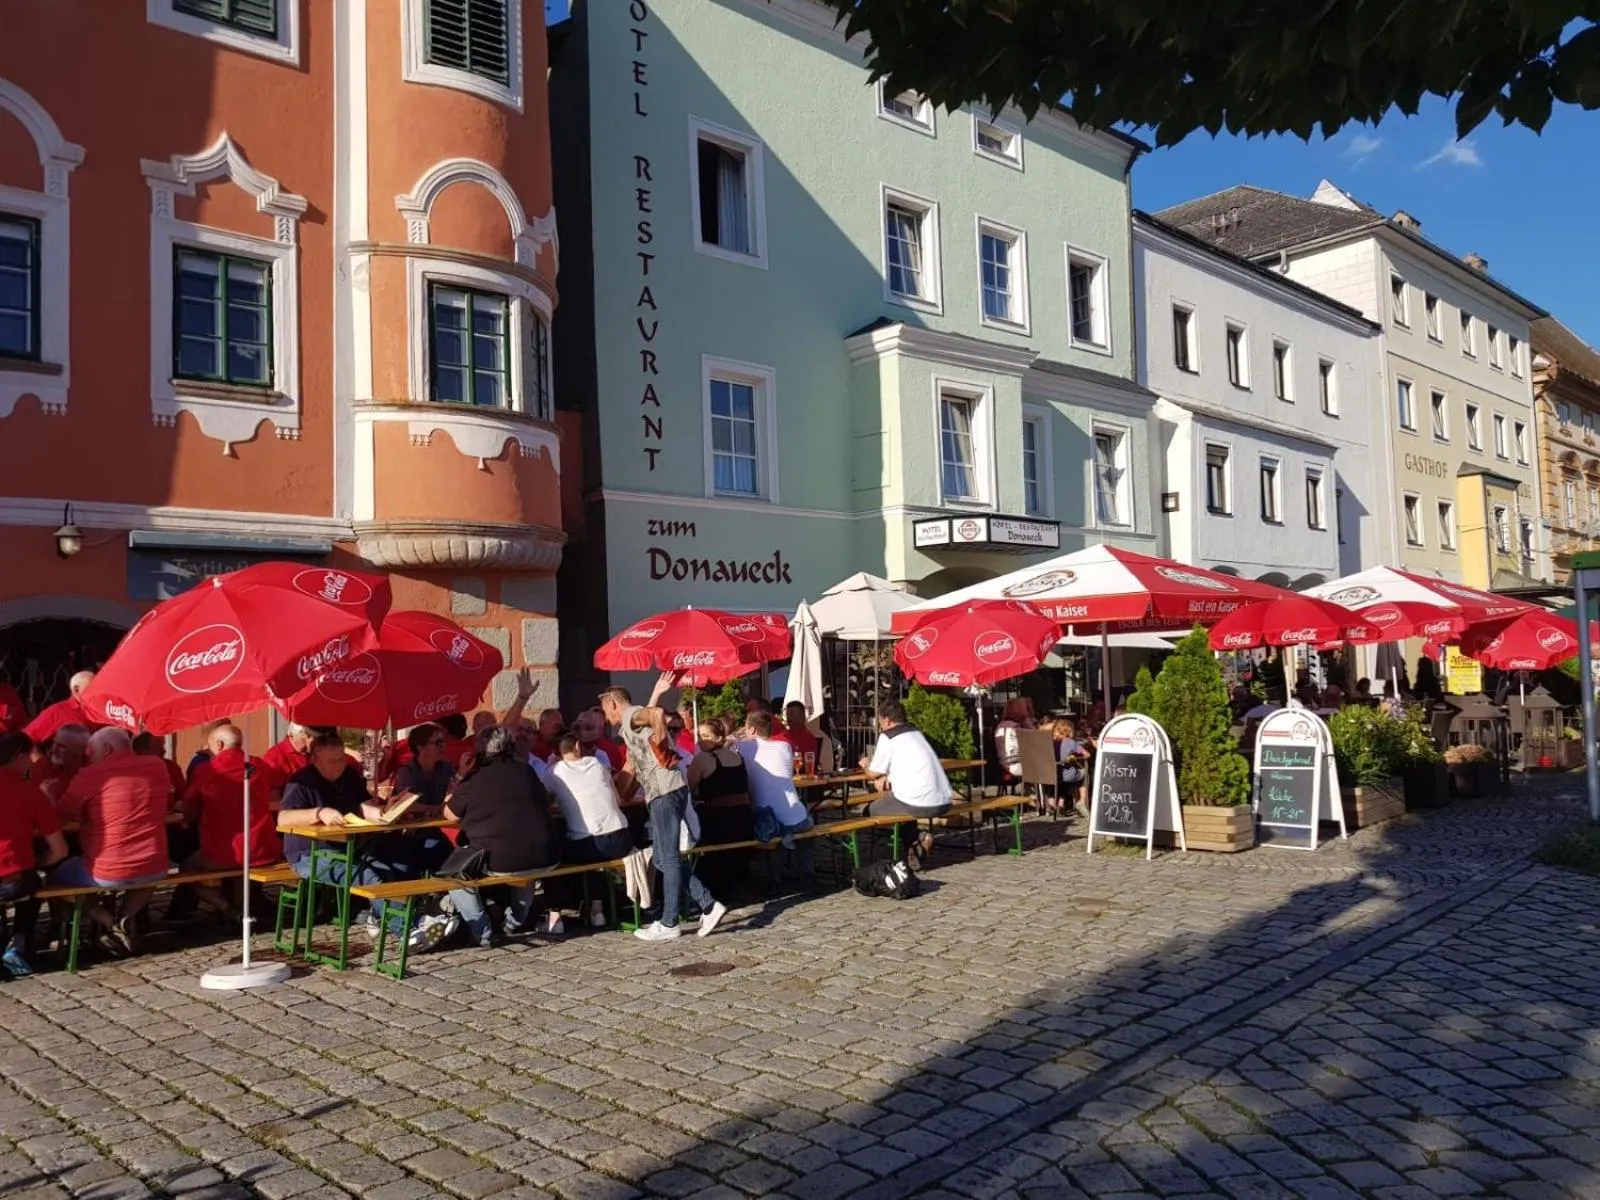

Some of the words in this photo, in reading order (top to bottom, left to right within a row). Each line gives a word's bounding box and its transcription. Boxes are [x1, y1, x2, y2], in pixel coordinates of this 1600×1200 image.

[1404, 452, 1449, 478] GASTHOF
[647, 519, 697, 537] zum
[646, 547, 793, 584] Donaueck
[1056, 604, 1088, 617] Kaiser
[1224, 632, 1252, 646] Coca-Cola
[1281, 628, 1318, 642] Coca-Cola
[978, 638, 1012, 656] Coca-Cola
[169, 640, 241, 675] Coca-Cola
[297, 634, 349, 679] Coca-Cola
[673, 651, 718, 668] Coca-Cola
[929, 671, 961, 685] Coca-Cola
[414, 694, 458, 719] Coca-Cola
